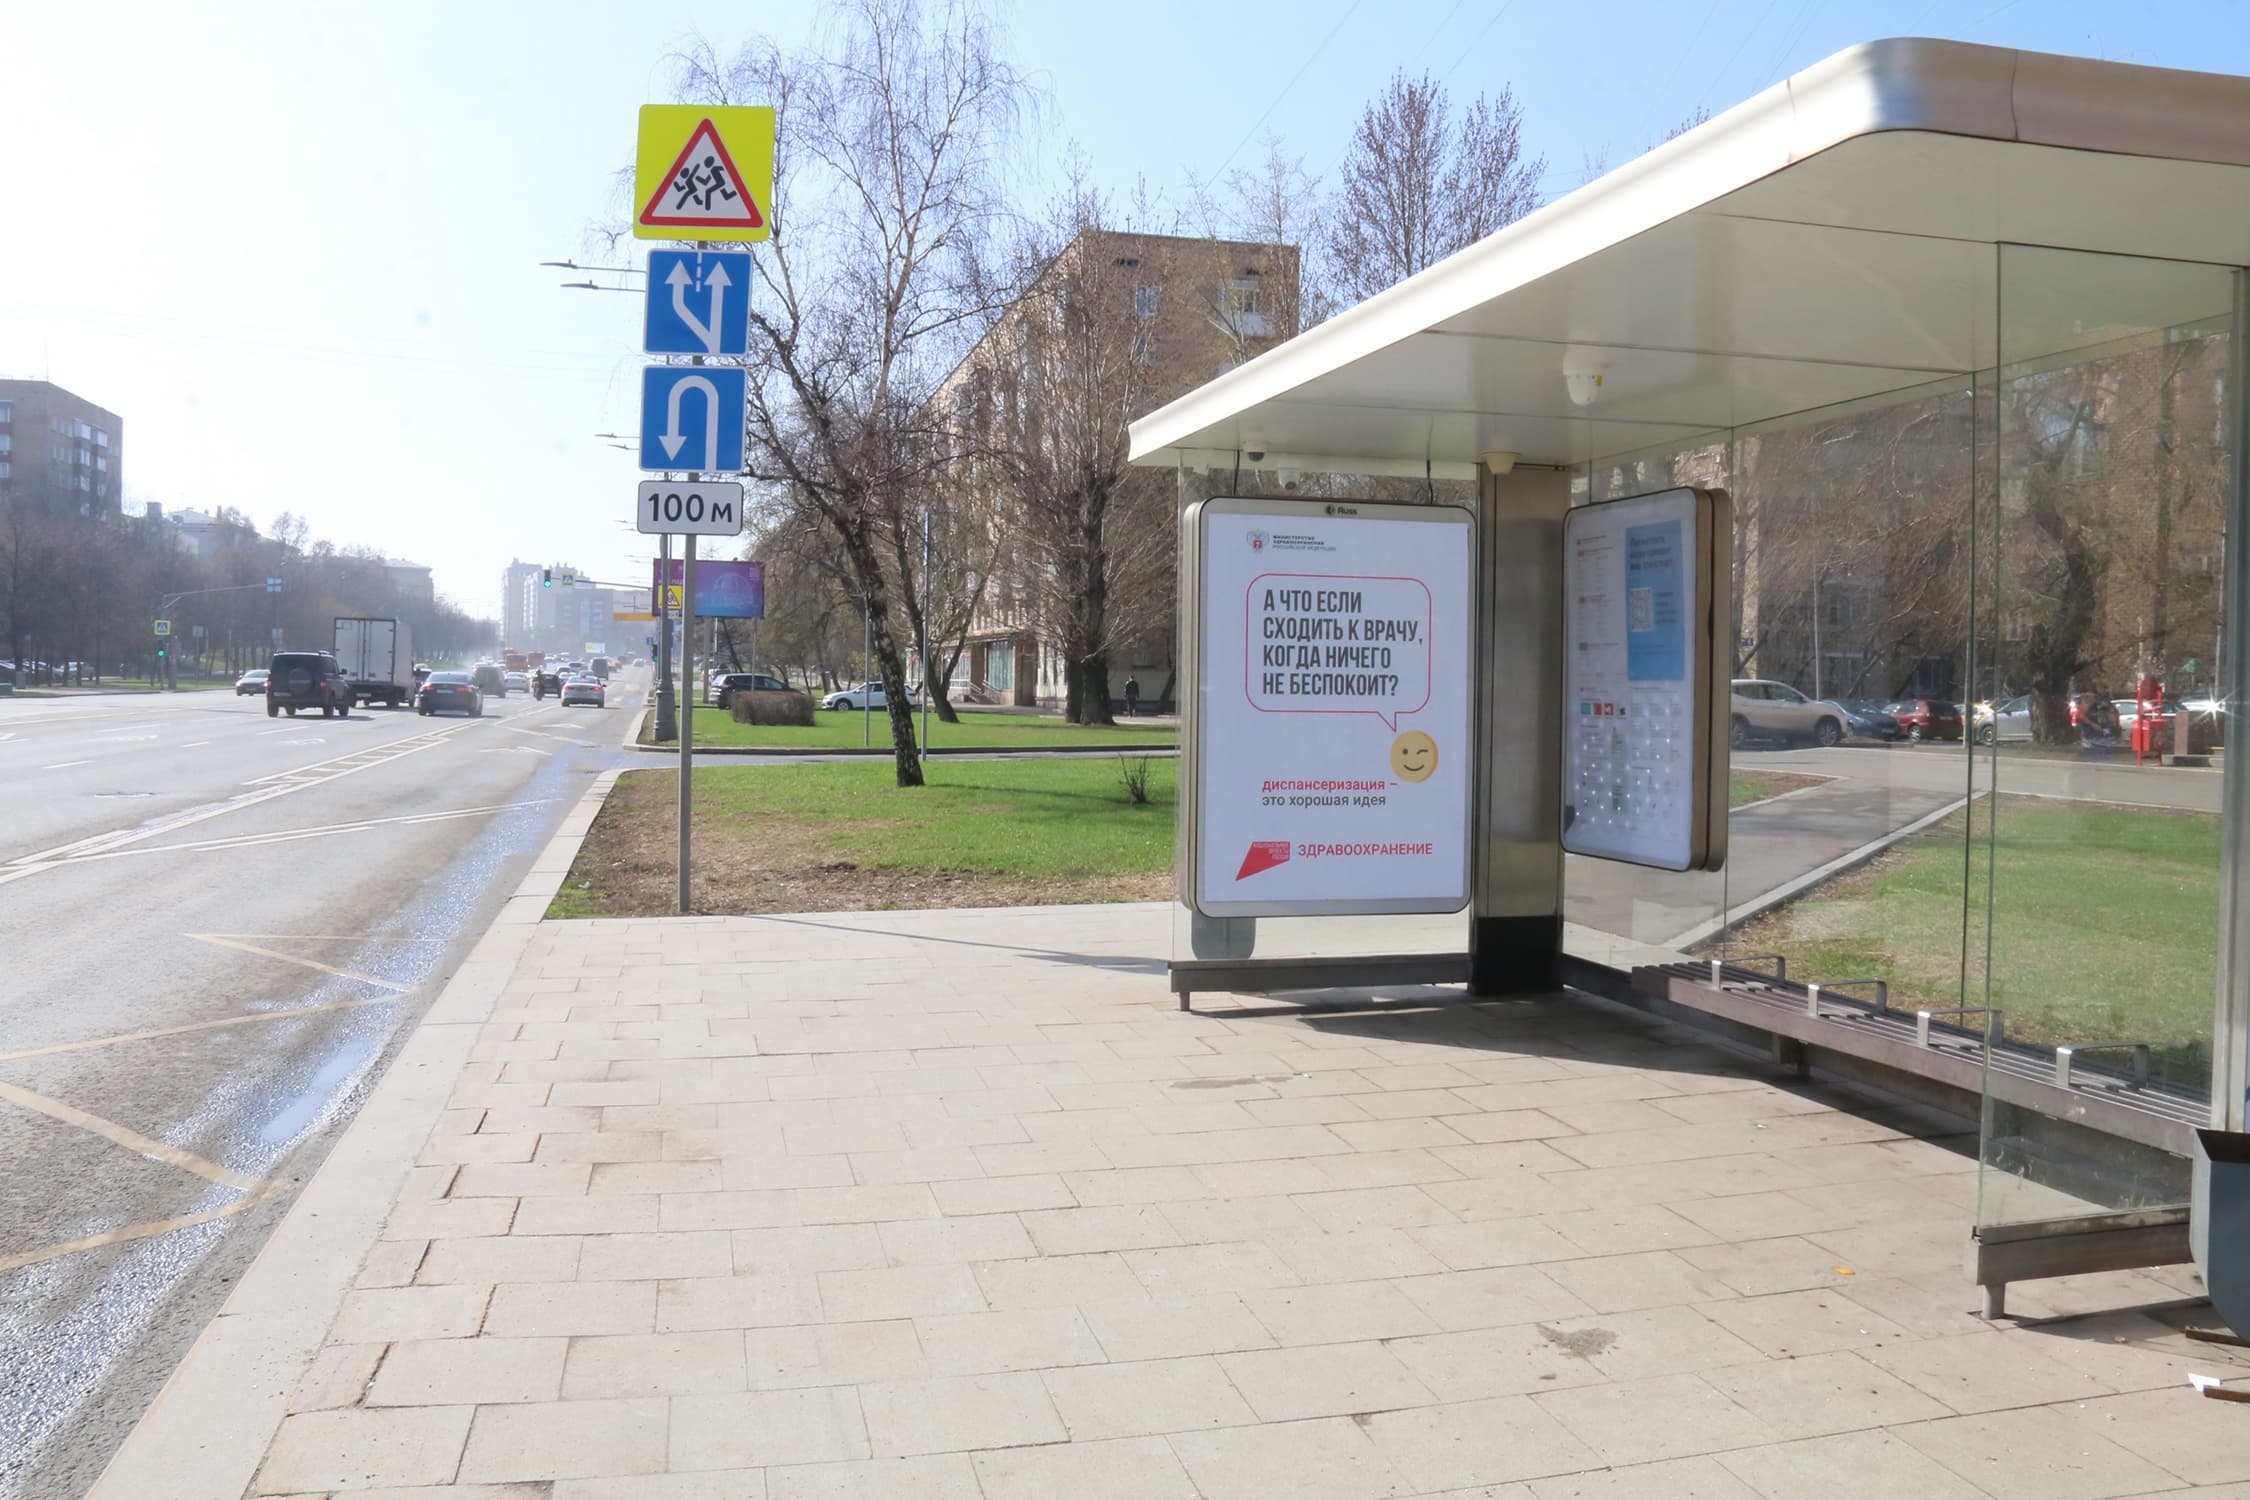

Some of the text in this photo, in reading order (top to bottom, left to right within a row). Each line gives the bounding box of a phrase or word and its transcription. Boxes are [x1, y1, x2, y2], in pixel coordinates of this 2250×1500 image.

[648, 493, 705, 522] 100
[1264, 590, 1361, 613] А ЧТО ЕСЛИ
[1264, 617, 1422, 644] СХОДИТЬ К ВРАЧУ,
[1264, 645, 1391, 670] КОГДА НИЧЕГО
[1263, 673, 1398, 696] НЕ БЕСПОКОИТ?
[1262, 781, 1384, 793] диспансеризация
[1262, 796, 1385, 808] это хорошая идея
[1298, 843, 1432, 858] ЗДРАВООХРАНЕНИЕ
